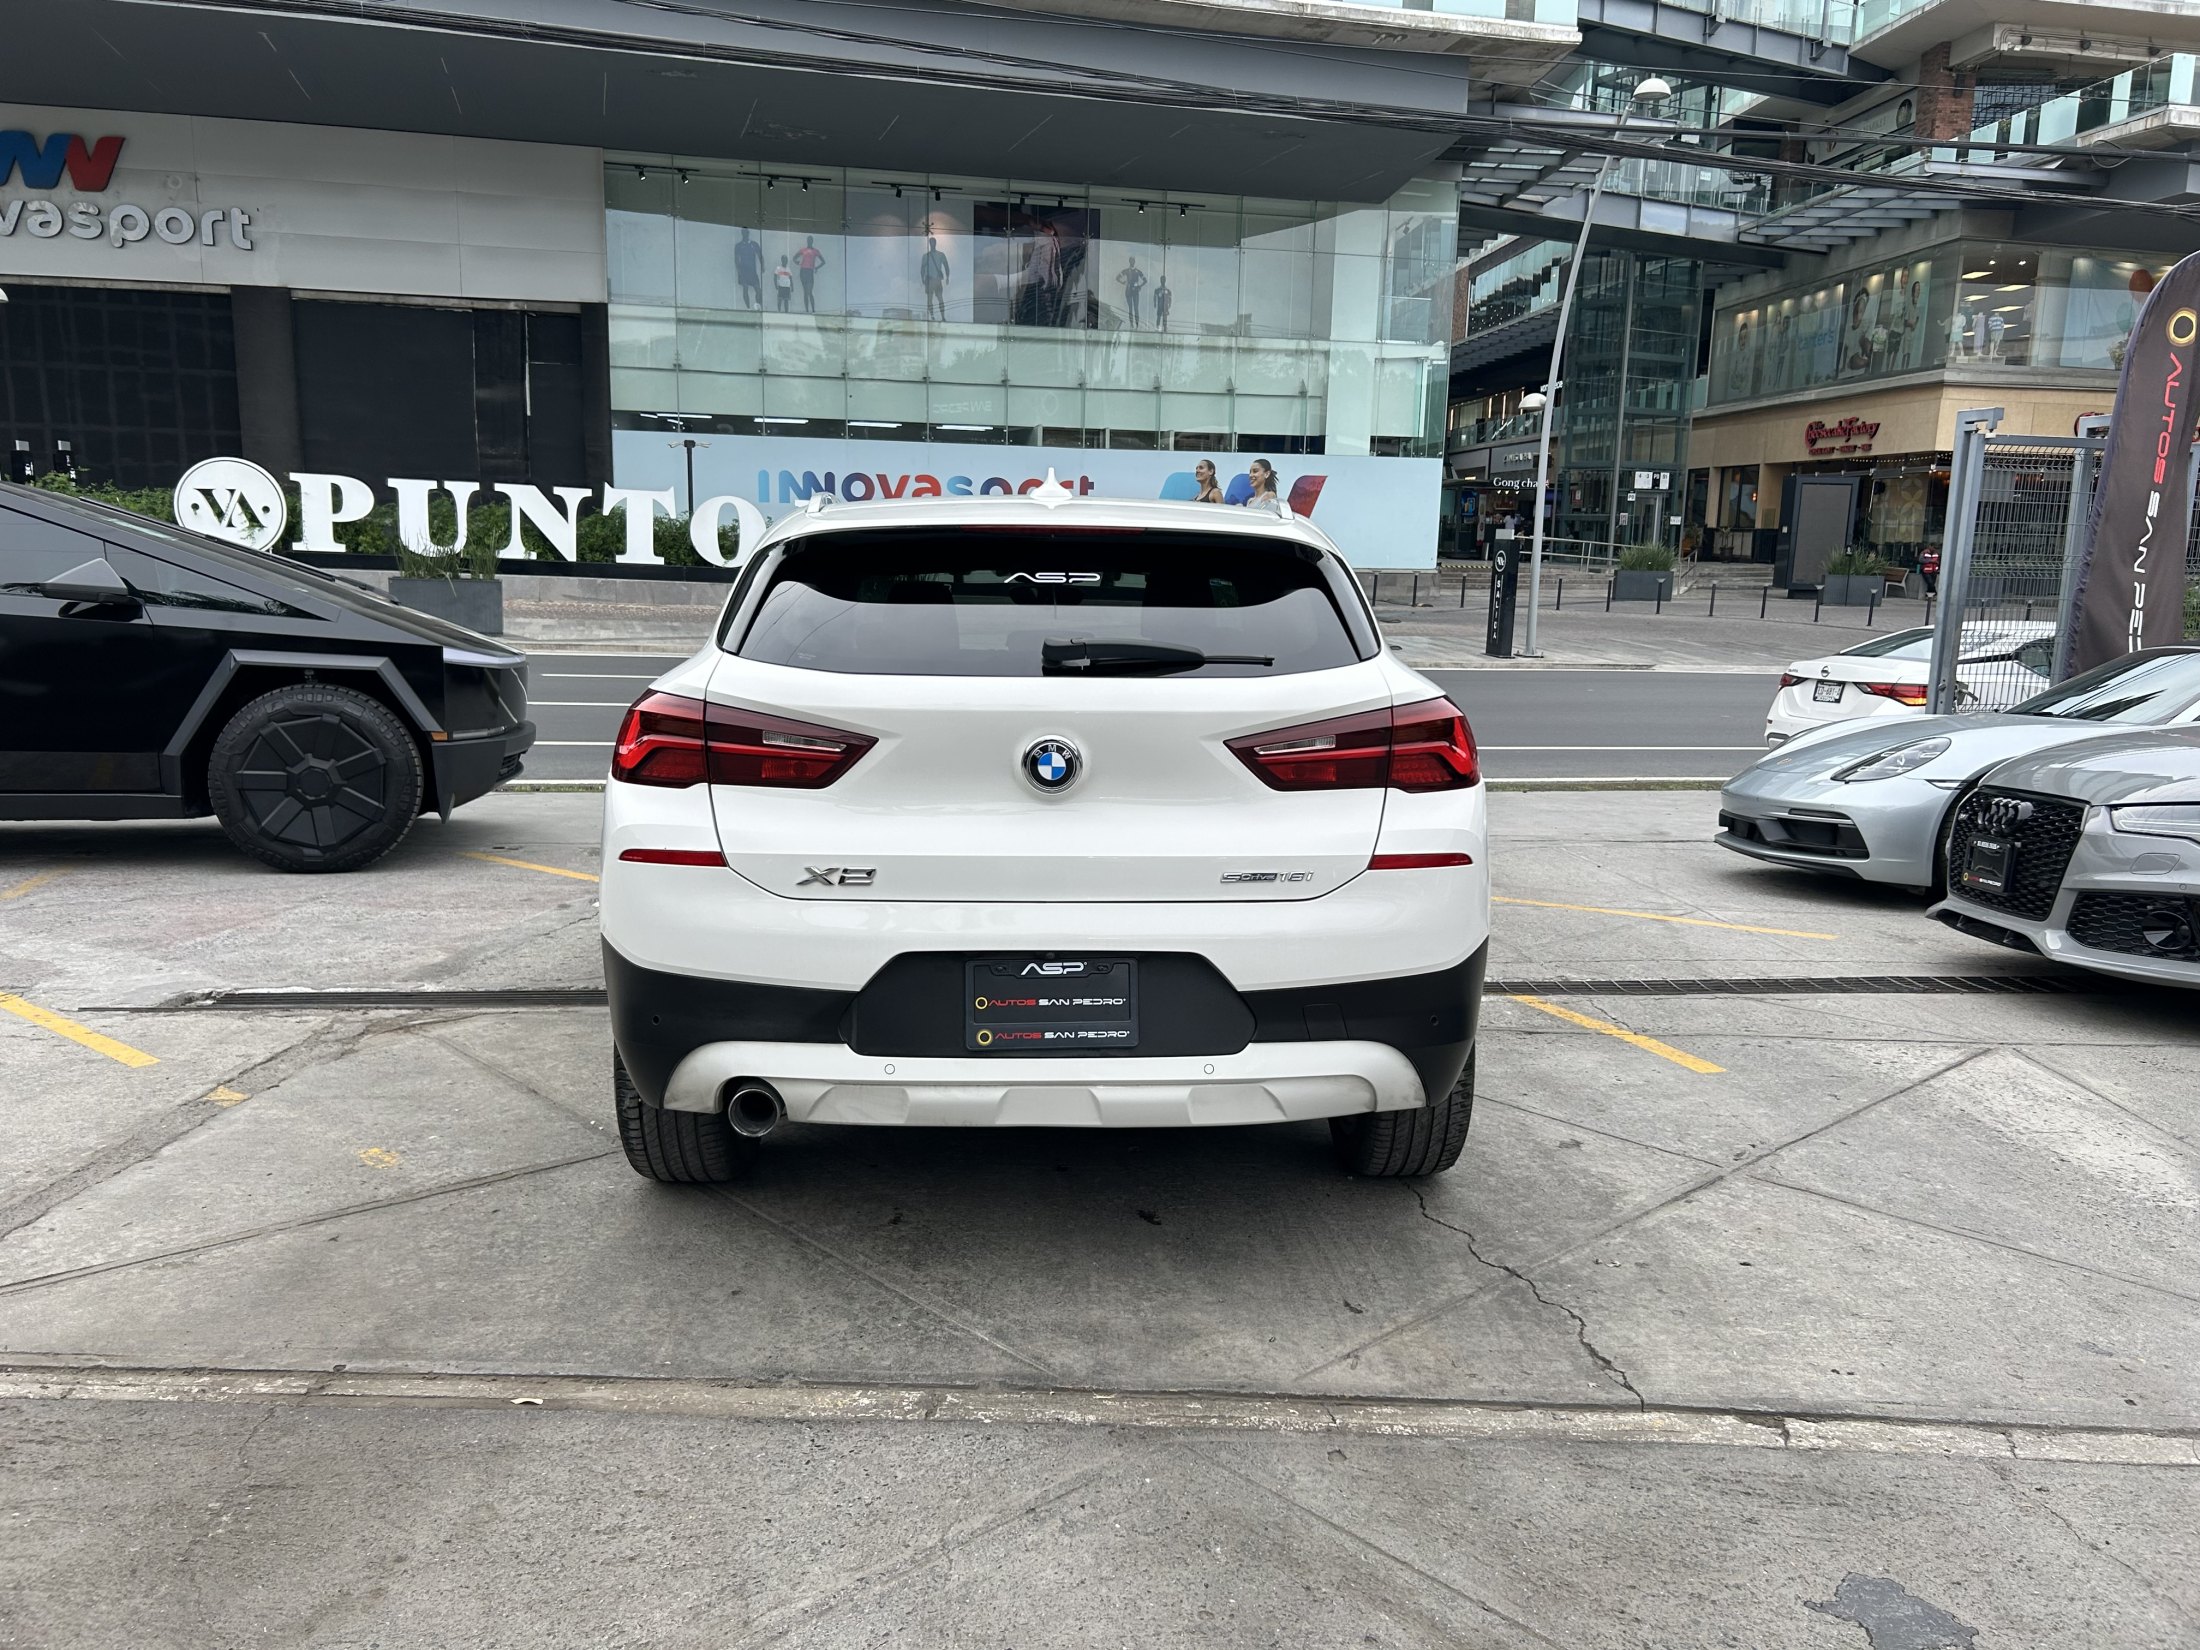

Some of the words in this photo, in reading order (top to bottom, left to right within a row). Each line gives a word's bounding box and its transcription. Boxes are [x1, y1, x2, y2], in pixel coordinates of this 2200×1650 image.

[2153, 352, 2183, 485] AUTOS
[1493, 477, 1520, 490] Gong
[1521, 477, 1539, 488] cha
[289, 471, 769, 569] PUNTO
[2133, 490, 2161, 573] SAN
[1003, 572, 1101, 583] ASP
[1033, 744, 1072, 760] BMW
[796, 866, 877, 886] X2
[1038, 998, 1070, 1006] SAN
[995, 1032, 1043, 1040] AUTOS
[1044, 1031, 1075, 1039] SAN
